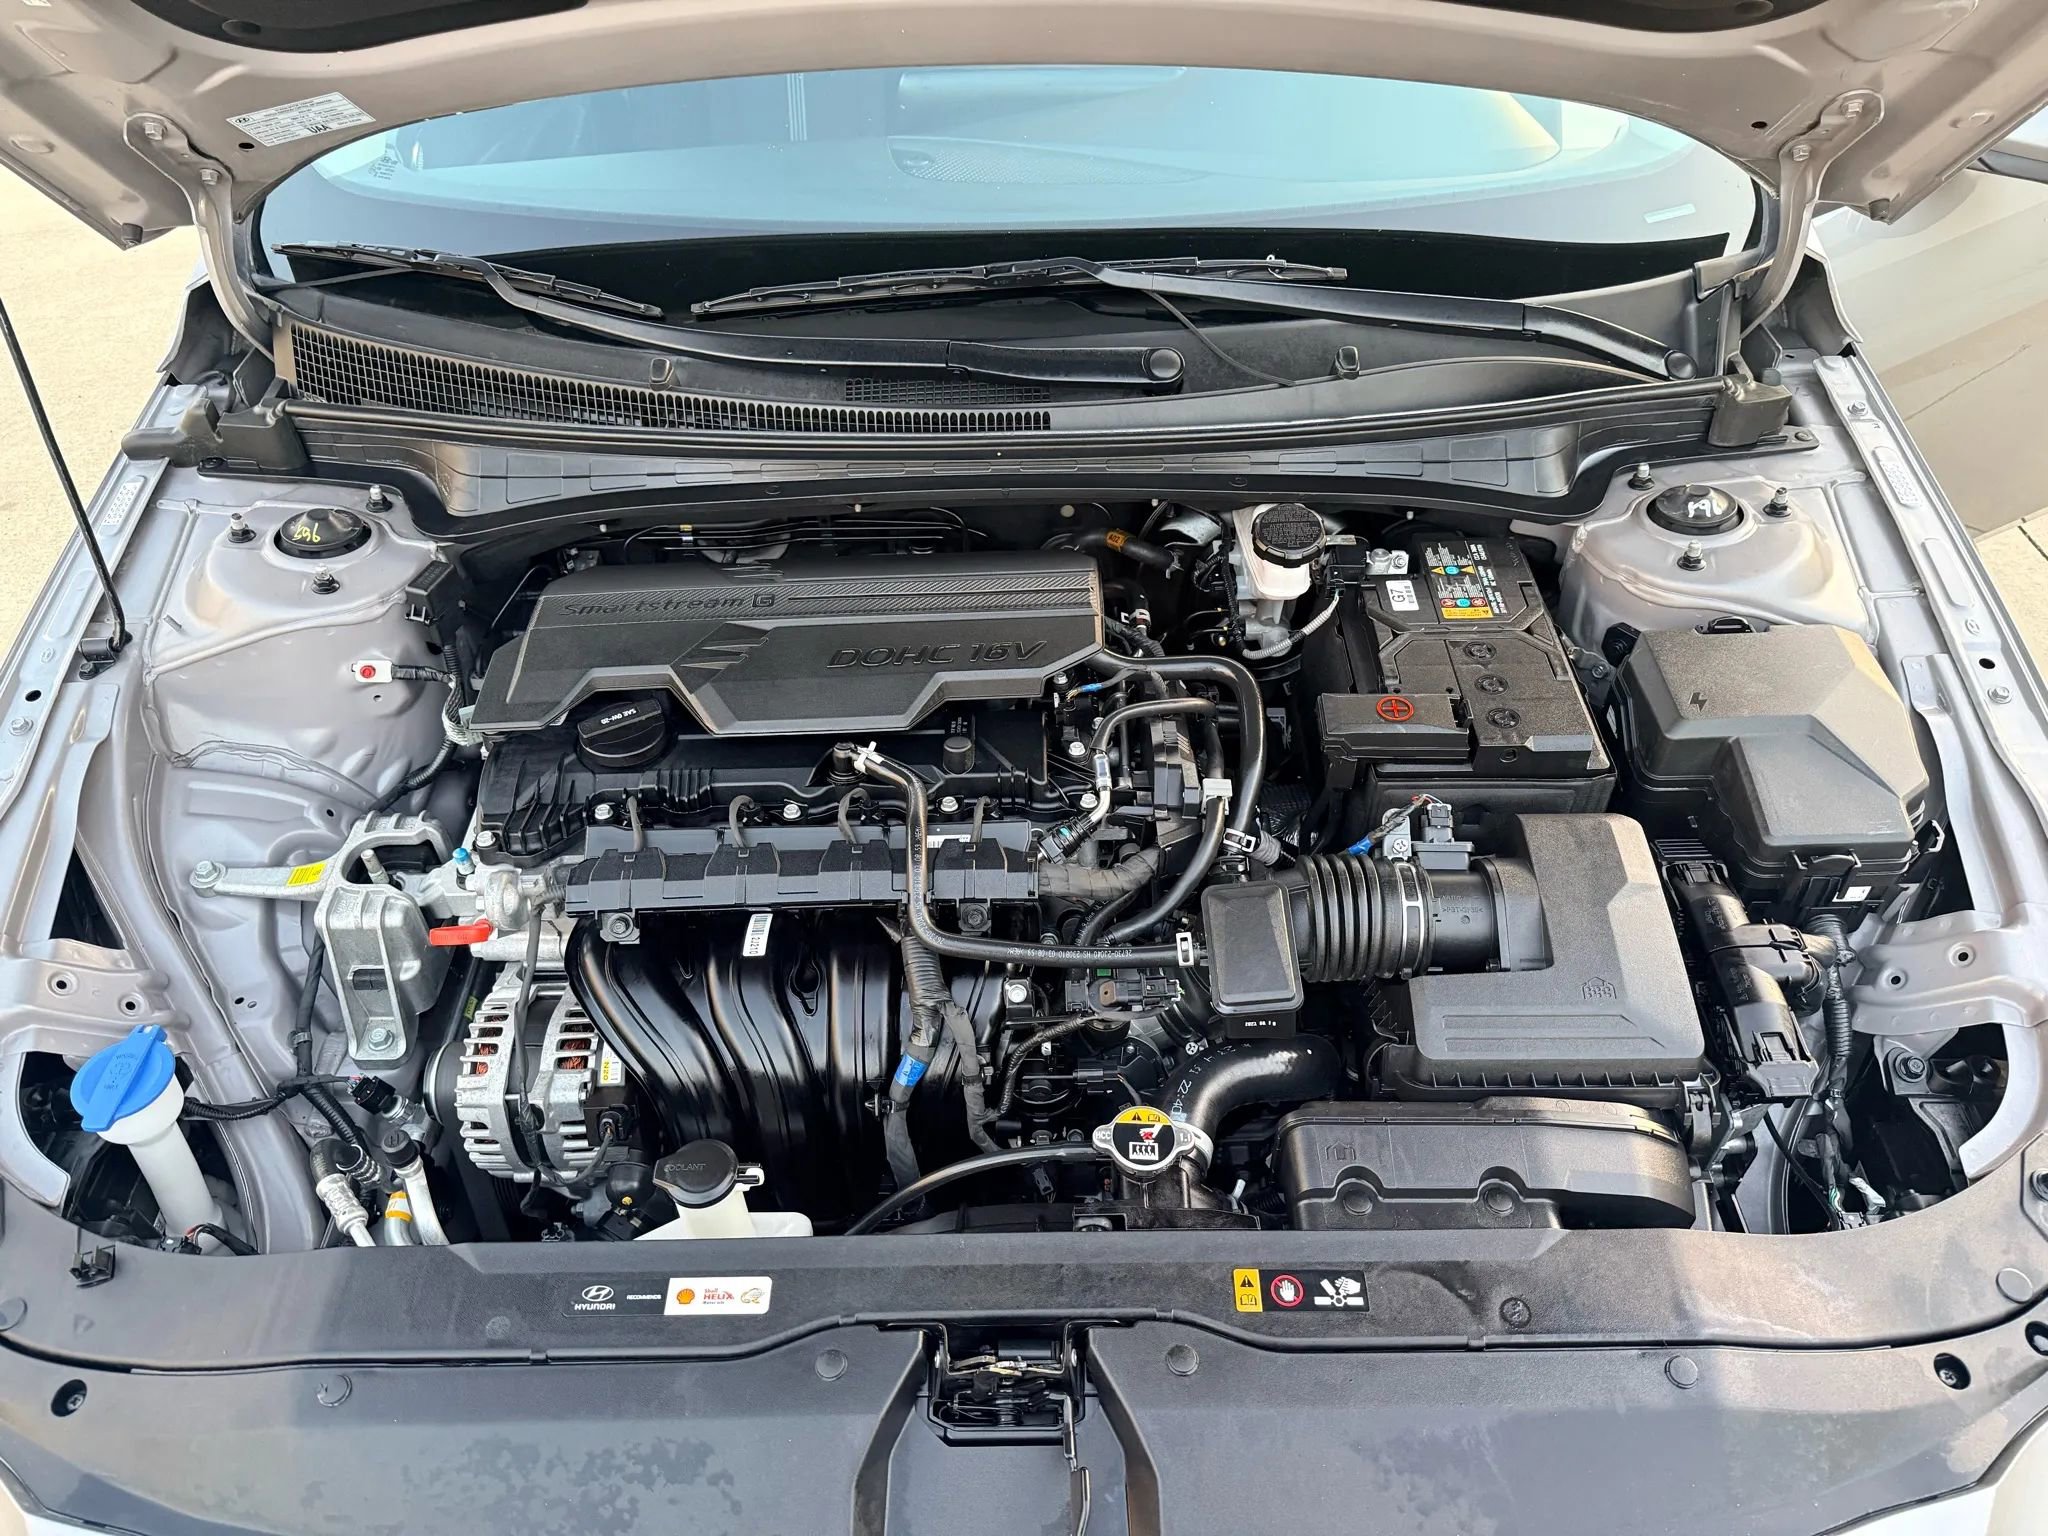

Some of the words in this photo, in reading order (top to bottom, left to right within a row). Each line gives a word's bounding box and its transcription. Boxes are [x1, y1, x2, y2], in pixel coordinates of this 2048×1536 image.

[1390, 589, 1406, 603] G7
[560, 597, 745, 616] Smartstream
[826, 643, 961, 669] DOHC
[968, 640, 1048, 663] 16V
[1094, 1130, 1112, 1140] HCC
[664, 1163, 706, 1172] COOLANT
[703, 1290, 734, 1300] HELIX
[574, 1302, 616, 1311] HYUNDAI
